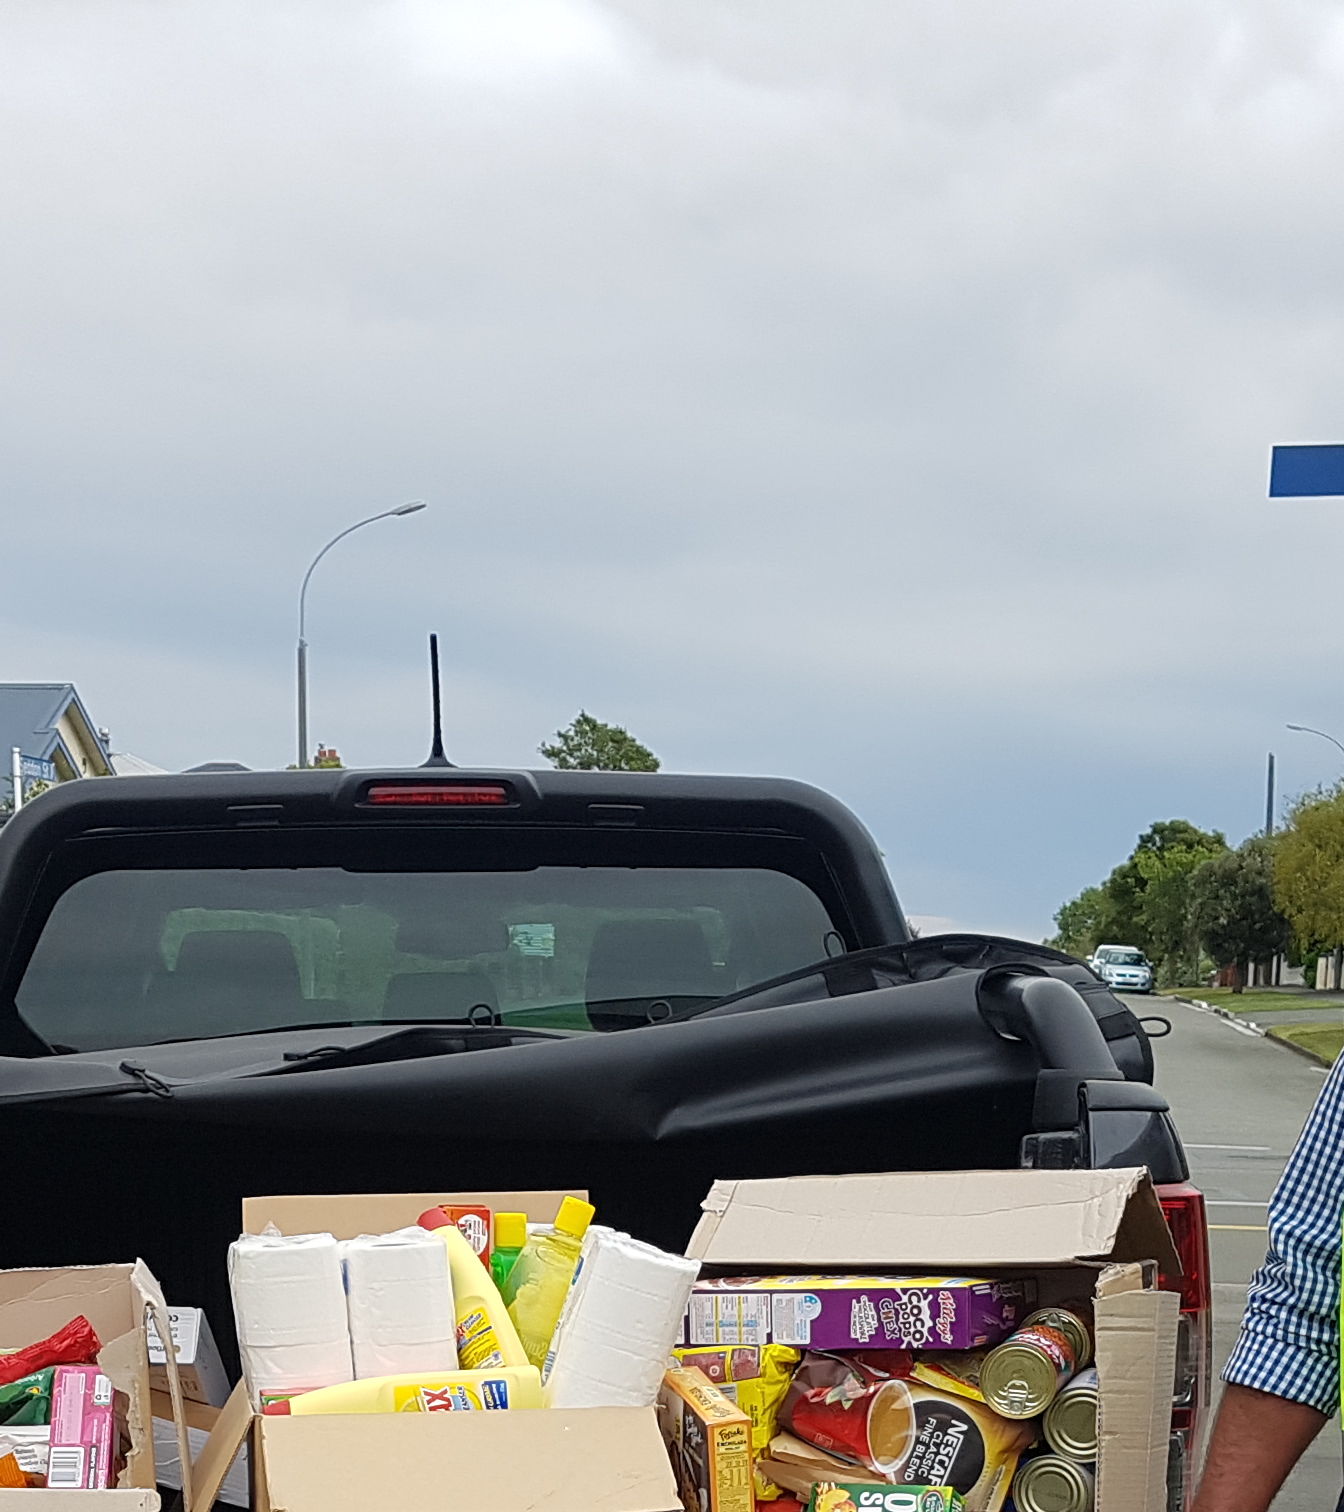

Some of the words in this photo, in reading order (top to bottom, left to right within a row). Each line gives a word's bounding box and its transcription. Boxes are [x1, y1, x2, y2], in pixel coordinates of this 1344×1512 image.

[896, 1302, 912, 1338] pops
[907, 1291, 926, 1342] COCO
[935, 1290, 956, 1344] Kellogg's
[918, 1417, 936, 1440] FINE
[904, 1445, 925, 1481] BLEND
[918, 1431, 942, 1477] CLASSIC
[928, 1419, 968, 1486] NESCAF
